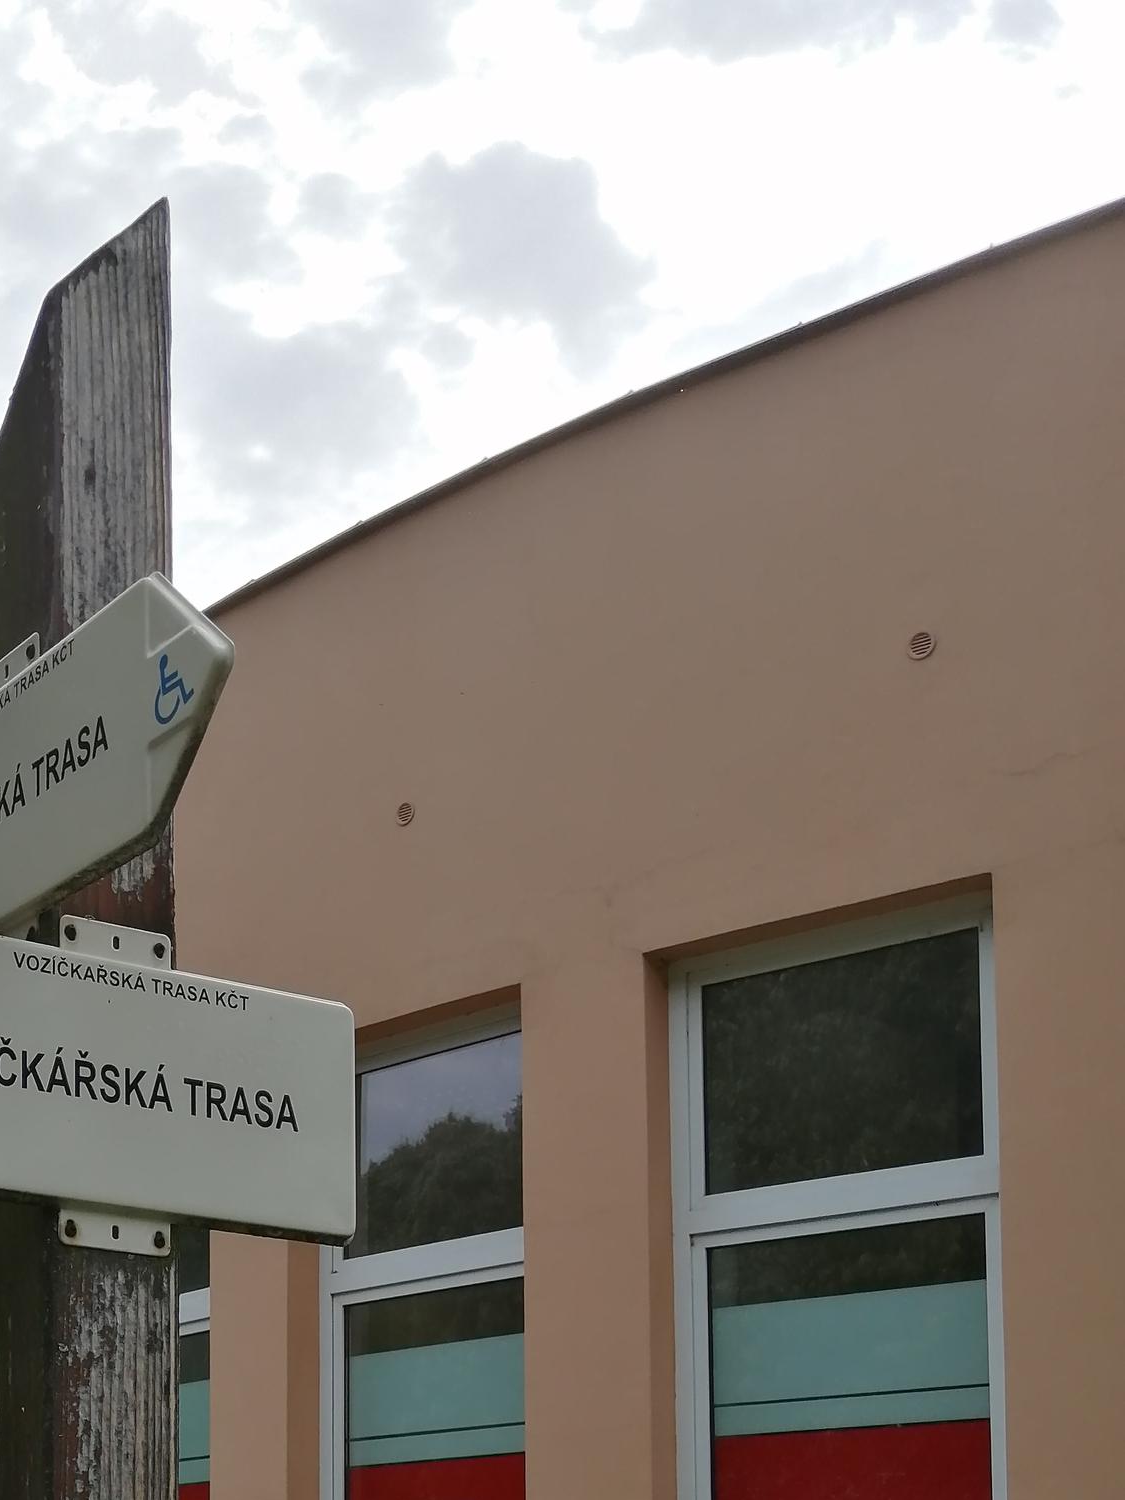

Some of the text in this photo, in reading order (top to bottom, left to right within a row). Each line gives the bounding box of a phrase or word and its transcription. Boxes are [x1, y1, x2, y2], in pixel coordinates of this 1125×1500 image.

[13, 660, 50, 698] TRASA
[52, 638, 75, 671] KČT
[31, 715, 109, 797] TRASA
[13, 951, 250, 1011] VOZÍČKAŘSKÁ TRASA KČT
[183, 1077, 299, 1133] TRASA
